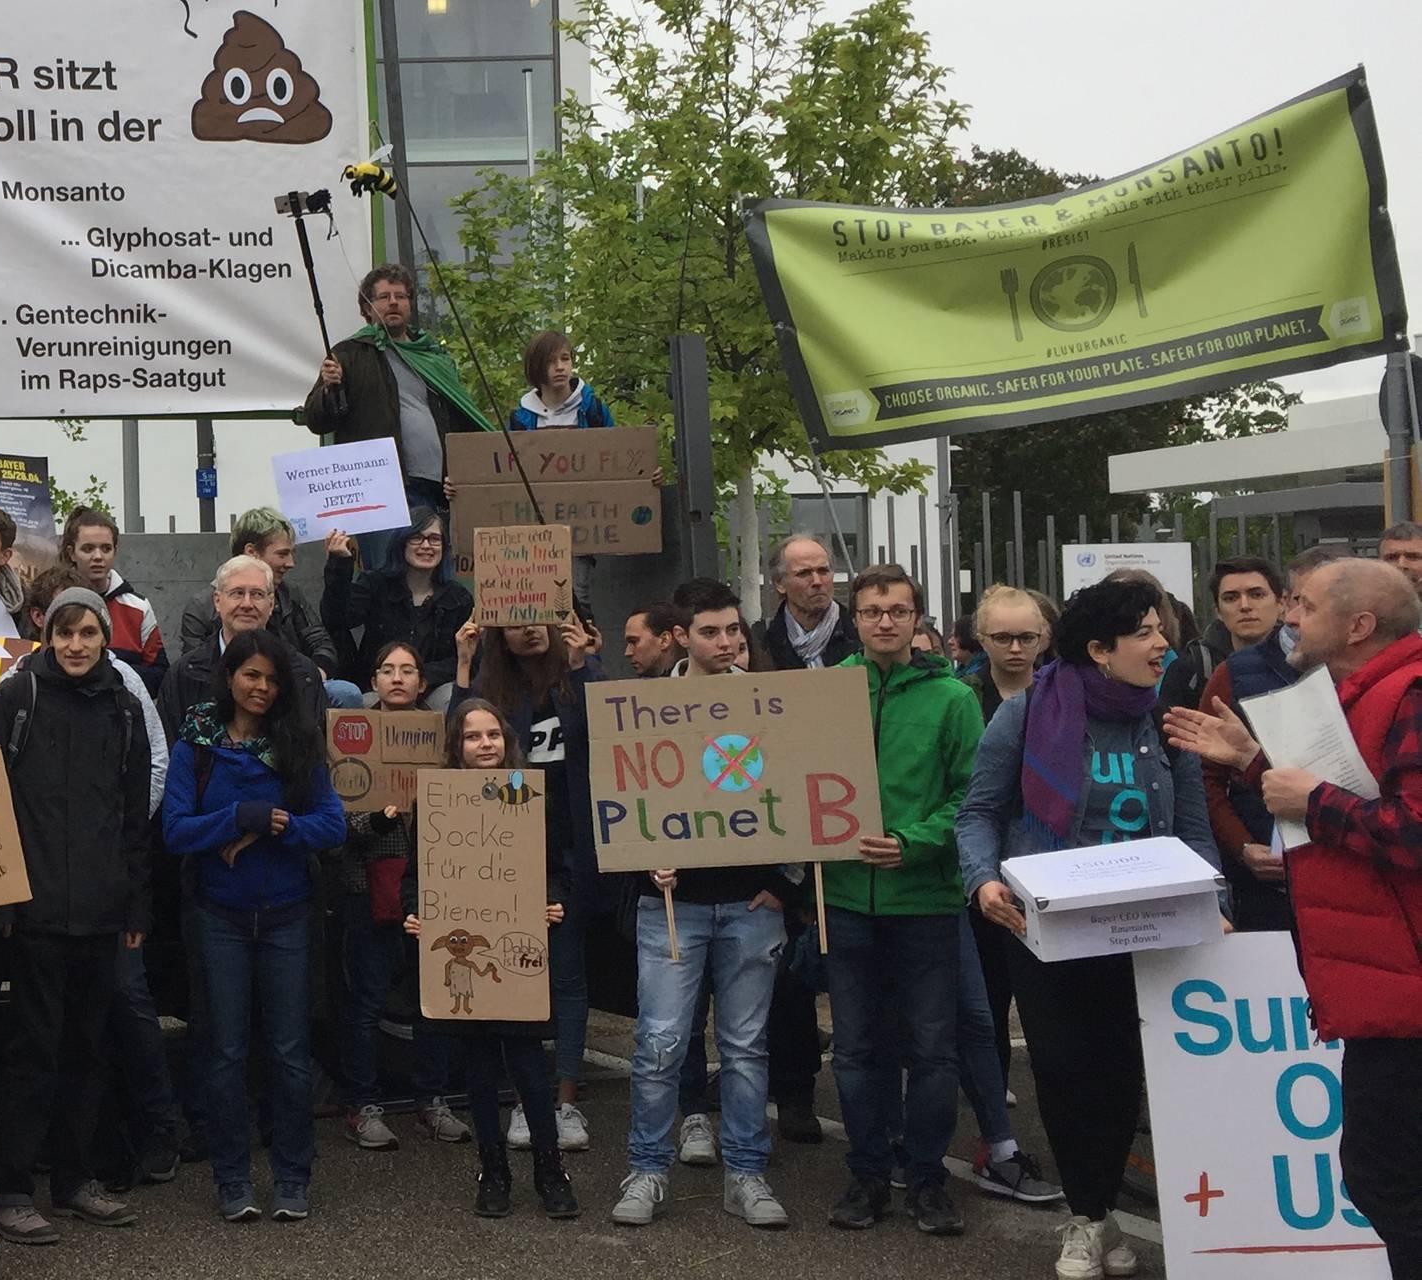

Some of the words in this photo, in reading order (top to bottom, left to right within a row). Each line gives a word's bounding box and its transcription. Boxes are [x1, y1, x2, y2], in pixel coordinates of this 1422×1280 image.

[33, 59, 118, 91] sitzt
[50, 109, 85, 142] in
[98, 109, 162, 142] der
[2, 181, 126, 203] Monsanto
[832, 216, 912, 248] STOP
[930, 211, 1039, 238] BAYER
[1054, 205, 1076, 224] &
[1086, 126, 1285, 208] MONSANTO!
[837, 240, 897, 264] Making
[900, 240, 933, 261] you
[933, 232, 979, 252] sick.
[1103, 200, 1139, 218] ills
[1142, 189, 1182, 210] with
[1183, 174, 1233, 200] their
[1236, 163, 1288, 191] pills.
[86, 227, 222, 252] Glyphosat-
[228, 227, 274, 248] und
[1041, 230, 1091, 251] #RESIST
[90, 258, 293, 286] Dicamba-Klagen
[15, 304, 168, 326] Gentechnik-
[16, 336, 232, 364] Verunreinigungen
[1045, 333, 1128, 359] #LUVORGANIC
[884, 388, 933, 410] CHOOSE
[936, 382, 995, 401] ORGANIC.
[997, 375, 1038, 395] SAFER
[1040, 369, 1066, 388] FOR
[1067, 363, 1103, 383] YOUR
[1103, 356, 1150, 378] PLATE.
[1152, 346, 1196, 368] SAFER
[1197, 338, 1224, 357] FOR
[1225, 332, 1253, 352] OUR
[1254, 318, 1313, 343] PLANET.
[20, 370, 50, 392] im
[58, 367, 227, 396] Raps-Saatgut
[285, 466, 331, 481] Werner
[331, 457, 390, 474] Baumann:
[538, 452, 586, 475] YOU
[308, 477, 362, 494] Rücktritt
[323, 491, 364, 509] JETZT!
[491, 501, 546, 523] THE
[554, 501, 619, 520] EARTH
[478, 528, 521, 547] Früher
[573, 525, 621, 545] DIE
[479, 548, 497, 563] der
[548, 544, 567, 560] der
[516, 577, 534, 591] die
[604, 695, 730, 732] There
[753, 687, 784, 716] is
[338, 721, 369, 741] STOP
[612, 739, 686, 792] NO
[427, 782, 482, 808] Eine
[596, 788, 787, 845] Planet
[805, 772, 861, 846] B
[423, 811, 515, 848] Socke
[423, 846, 467, 880] für
[478, 852, 517, 883] die
[421, 889, 519, 924] Bienen!
[1090, 914, 1118, 925] Bayer
[1119, 911, 1140, 922] CEO
[1141, 909, 1179, 920] Werner
[1109, 936, 1131, 947] Step
[1132, 933, 1162, 944] down!
